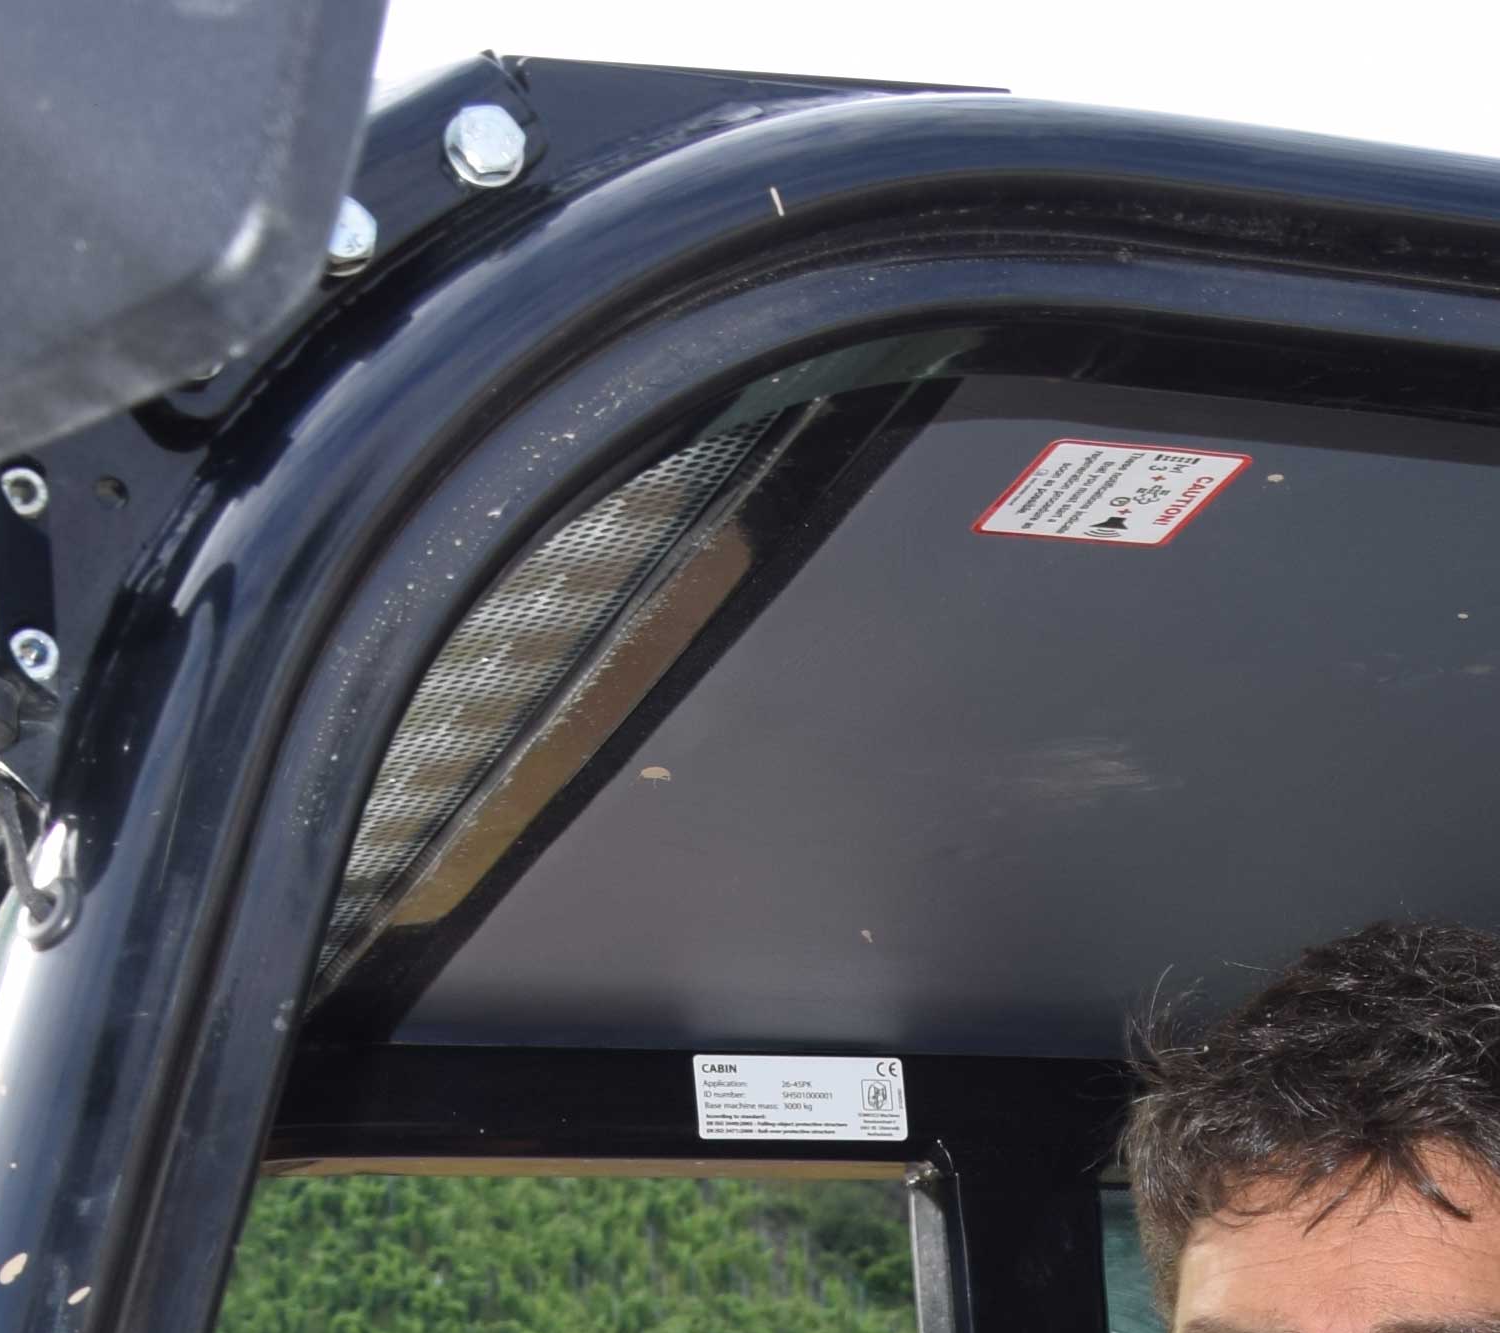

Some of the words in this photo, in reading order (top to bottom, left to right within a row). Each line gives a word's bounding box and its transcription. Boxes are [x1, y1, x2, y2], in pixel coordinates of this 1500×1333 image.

[1152, 476, 1215, 526] CAUTION!
[702, 1064, 737, 1073] CABIN
[703, 1080, 747, 1089] Application:
[803, 1103, 812, 1112] kg
